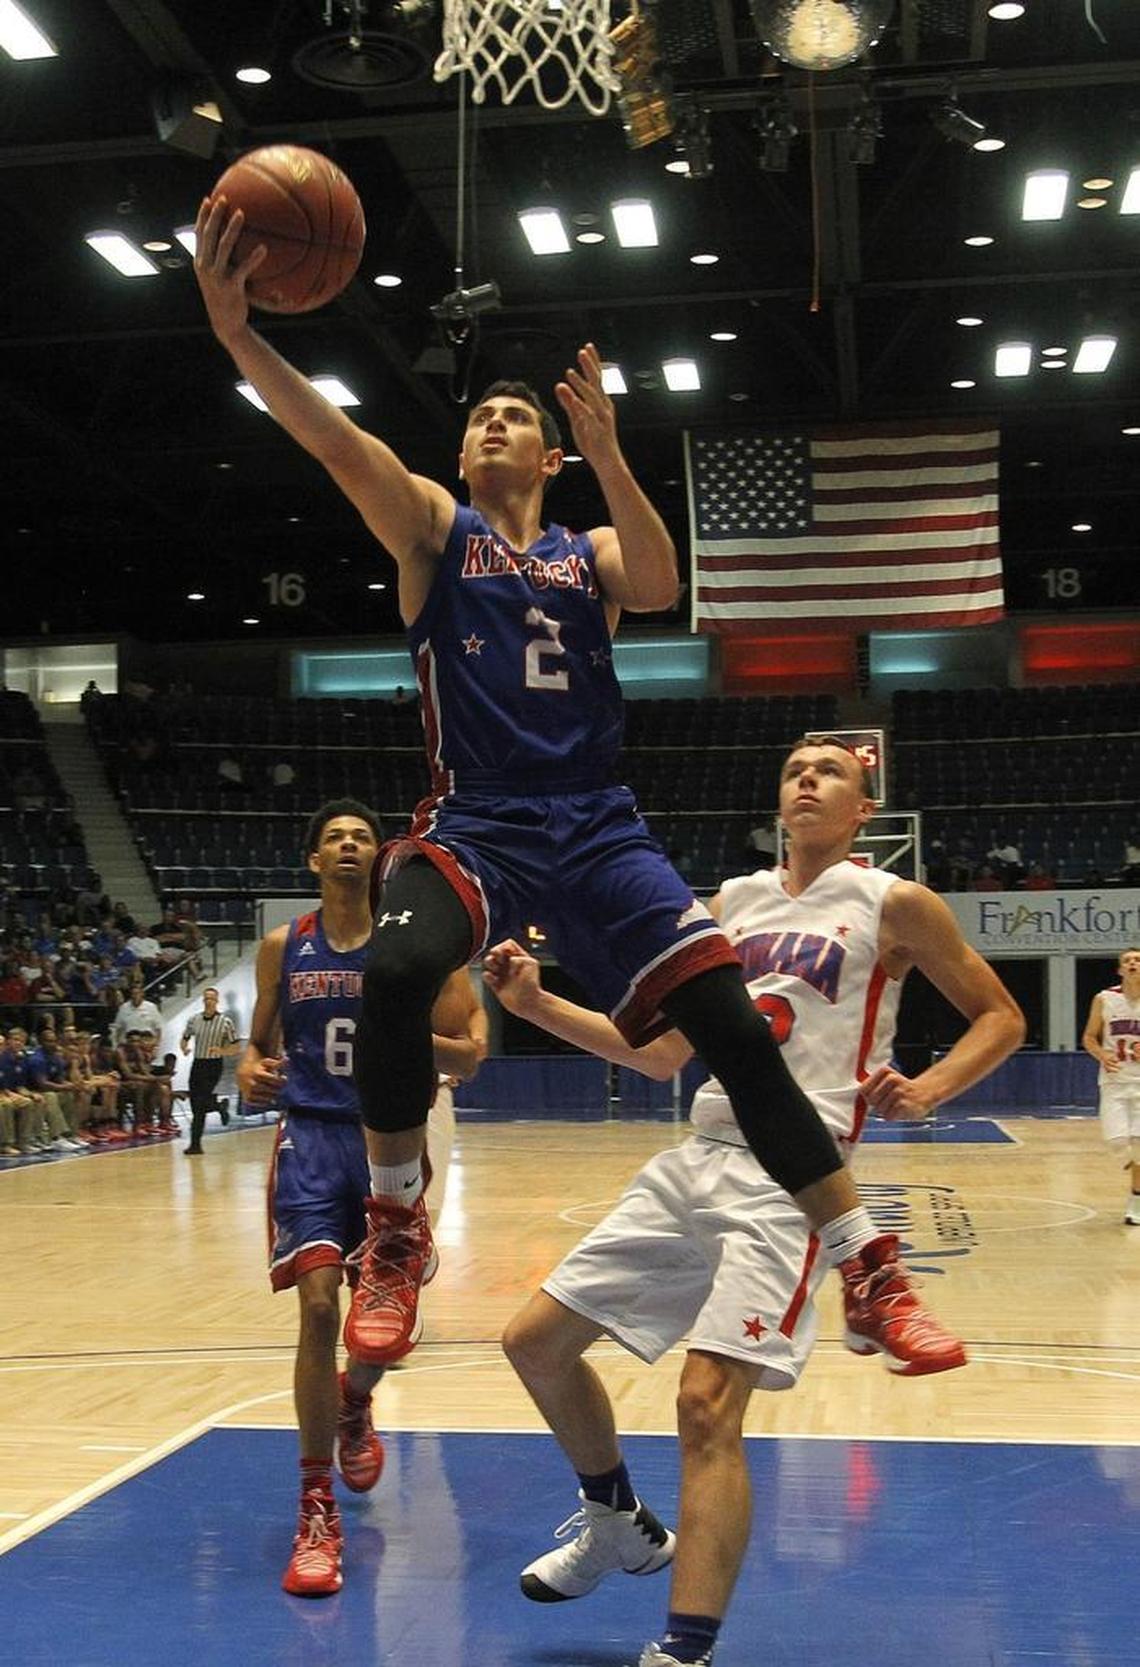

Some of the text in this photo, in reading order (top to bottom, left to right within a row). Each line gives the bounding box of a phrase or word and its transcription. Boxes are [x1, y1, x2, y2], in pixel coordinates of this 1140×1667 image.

[262, 572, 305, 606] 16
[1041, 568, 1081, 598] 18
[525, 606, 569, 690] 2
[325, 1017, 357, 1076] 6
